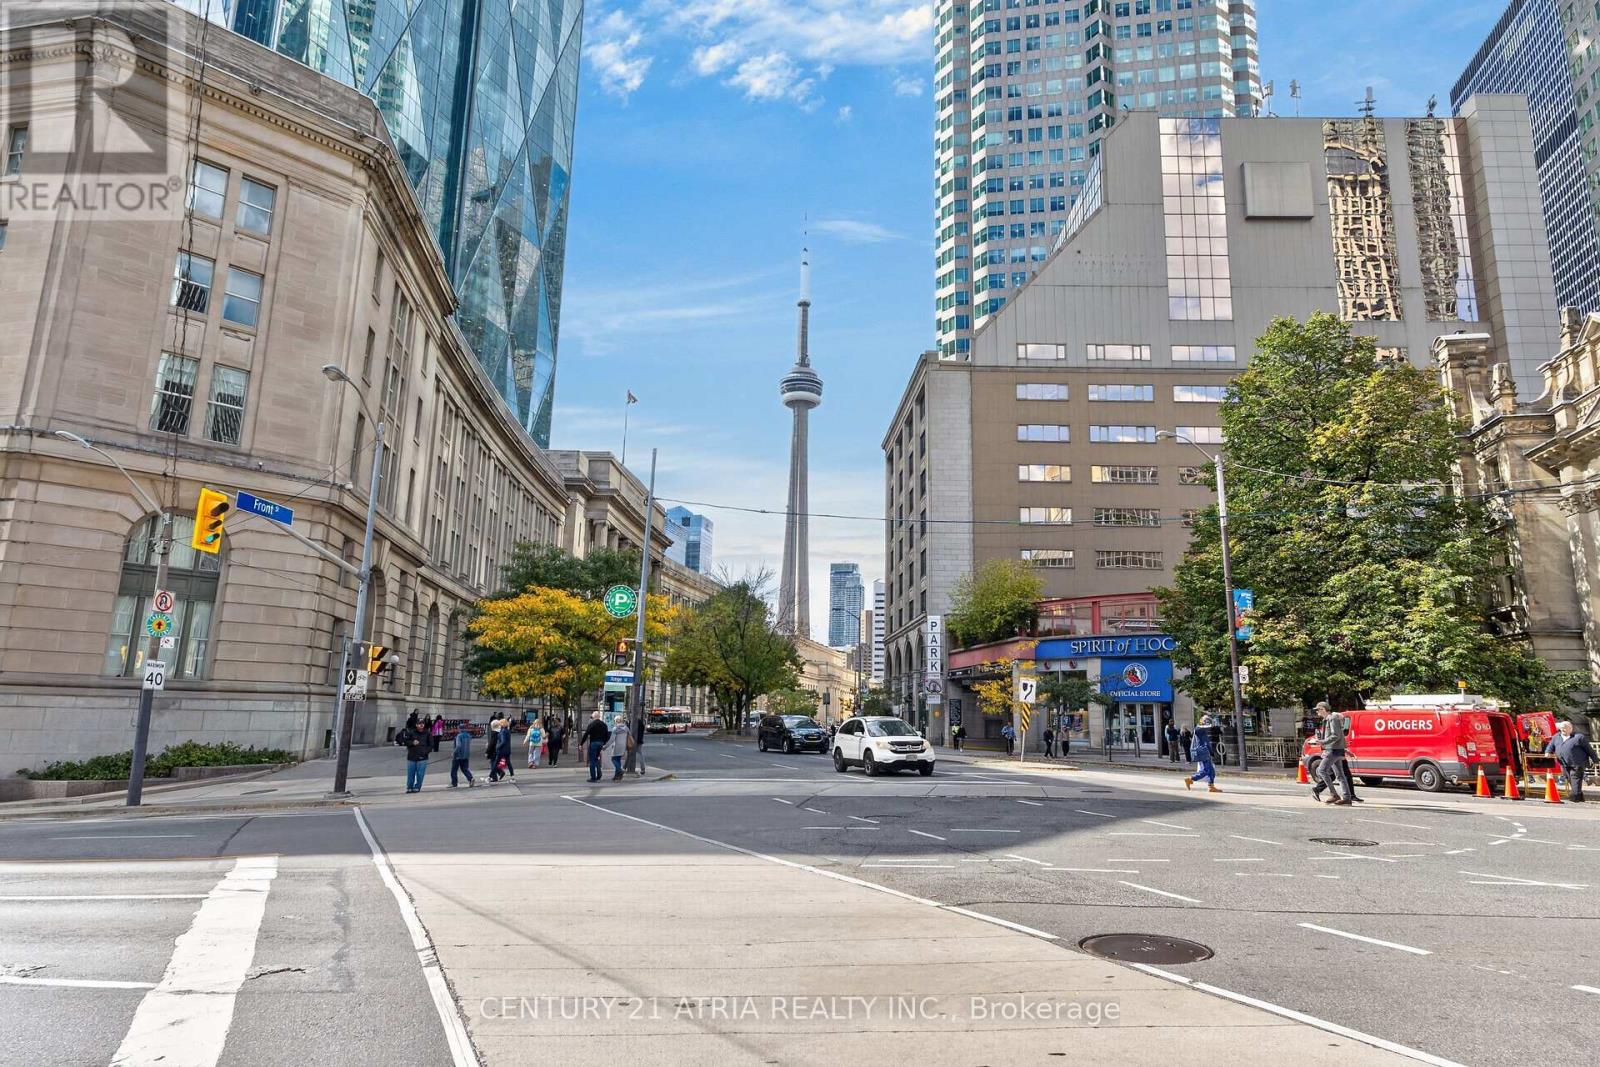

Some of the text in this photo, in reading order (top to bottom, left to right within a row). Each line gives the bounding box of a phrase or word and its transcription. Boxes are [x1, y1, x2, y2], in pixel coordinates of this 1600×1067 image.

[253, 498, 274, 515] Front
[930, 621, 938, 671] PARK
[1070, 637, 1182, 656] SPIRIT of HOC
[146, 672, 163, 686] 40
[1387, 719, 1433, 730] ROGERS
